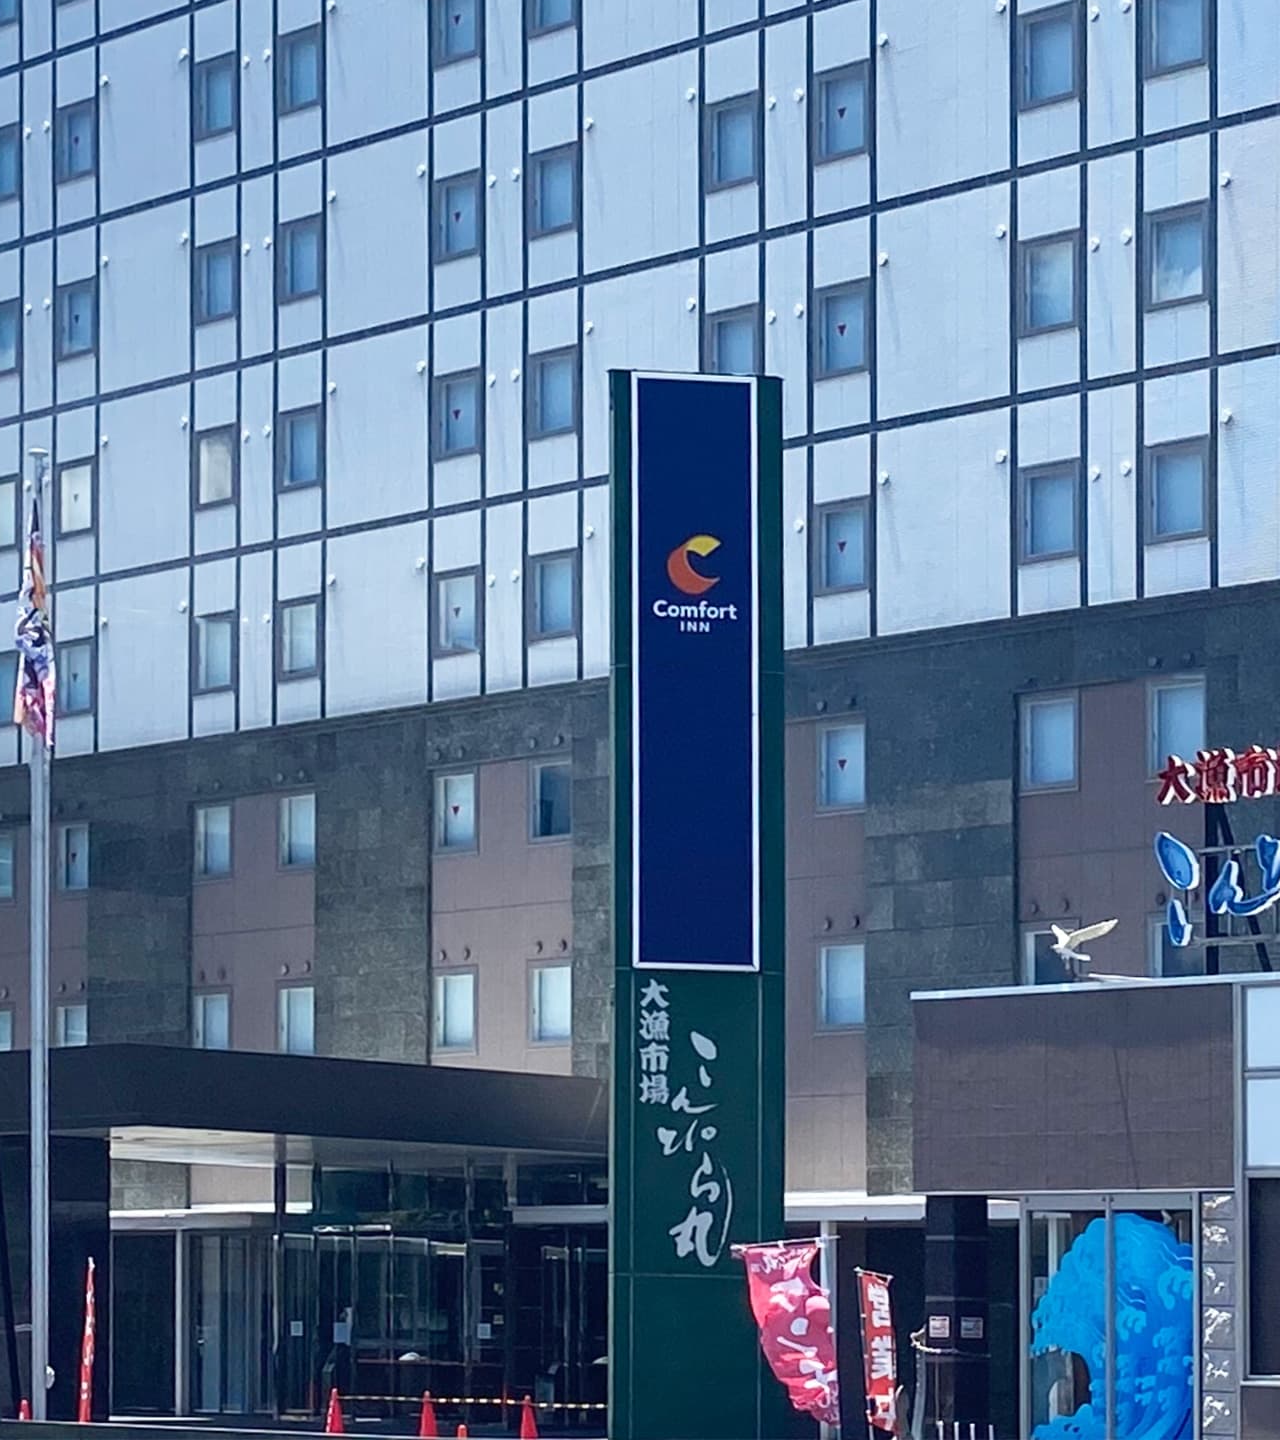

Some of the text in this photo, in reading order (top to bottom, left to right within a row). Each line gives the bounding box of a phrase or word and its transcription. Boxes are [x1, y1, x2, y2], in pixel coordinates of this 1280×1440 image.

[652, 599, 738, 621] Comfort
[680, 622, 711, 633] INN
[639, 978, 670, 1105] 大漁市場
